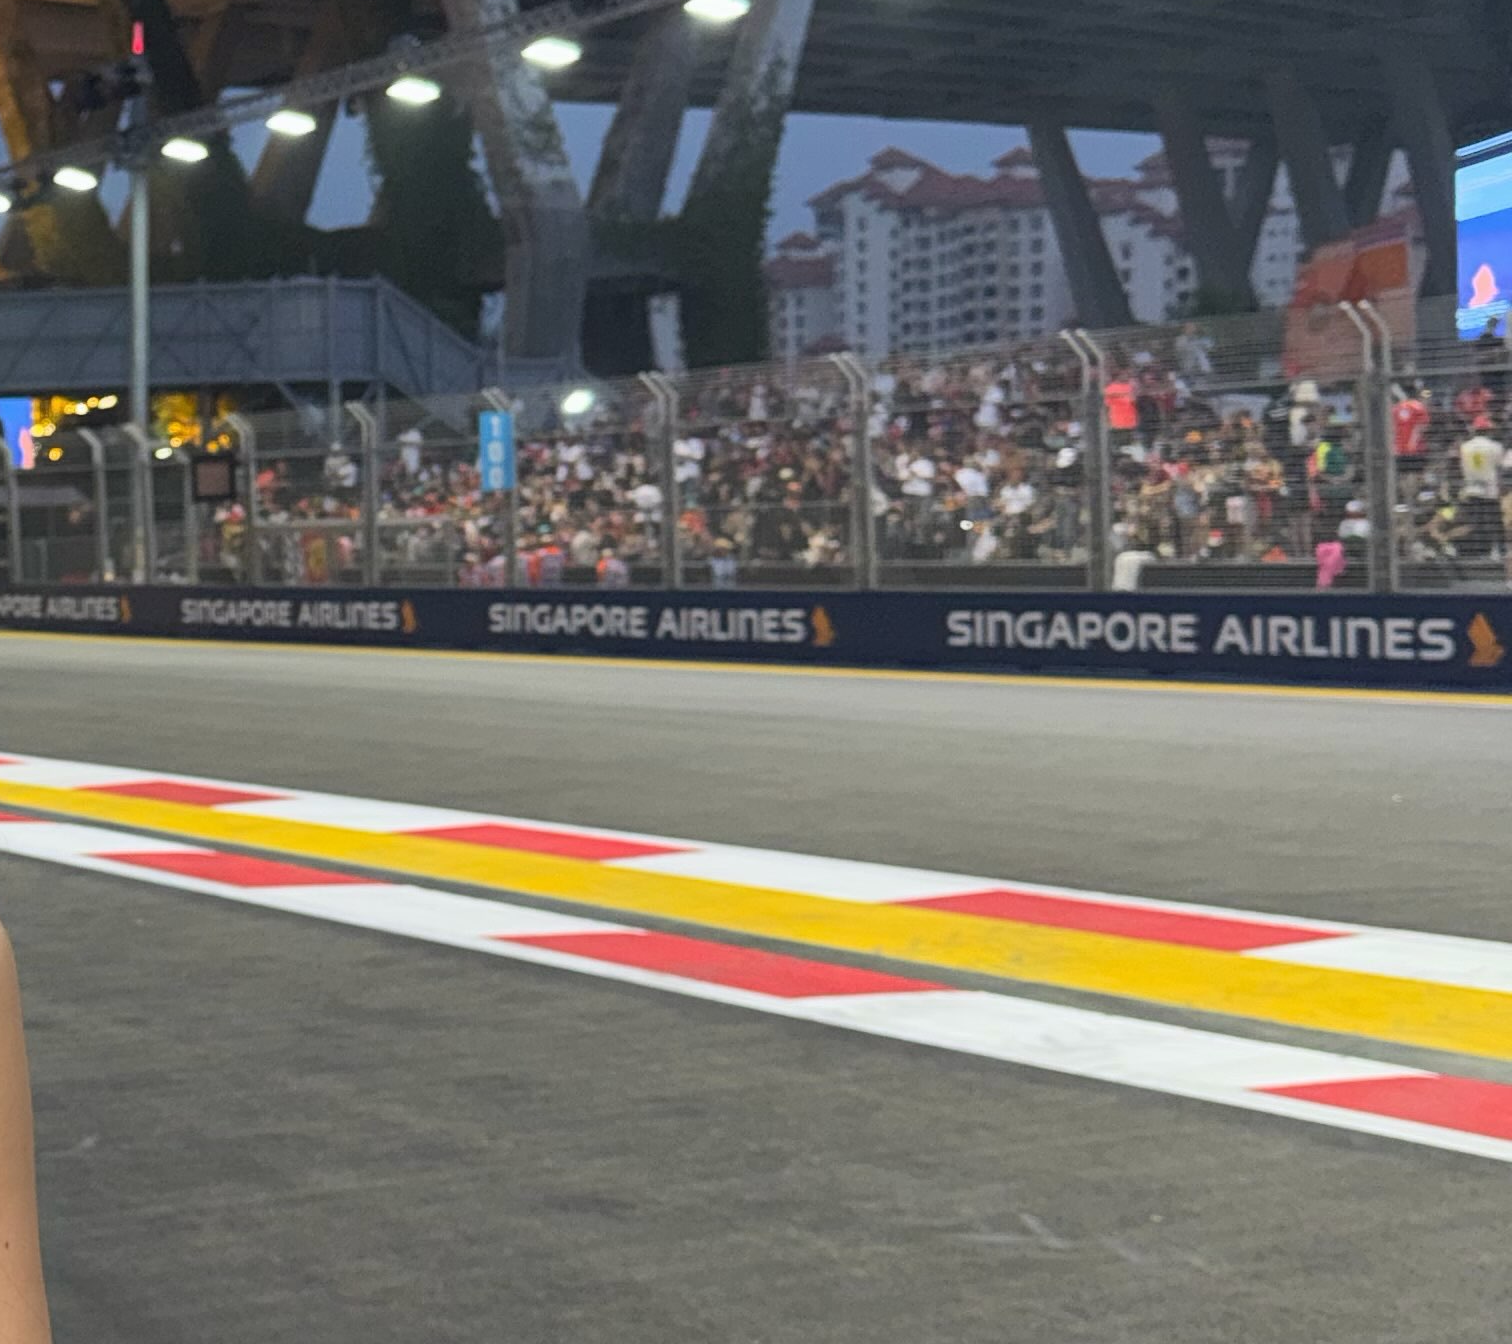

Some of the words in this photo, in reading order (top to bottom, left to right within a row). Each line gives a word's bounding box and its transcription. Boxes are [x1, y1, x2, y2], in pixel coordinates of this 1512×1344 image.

[297, 601, 398, 631] AIRLINES
[489, 603, 648, 639] SINGAPORE
[656, 608, 807, 644] AIRLINES
[946, 609, 1198, 654] SINGAPORE
[1213, 614, 1456, 662] AIRLINES
